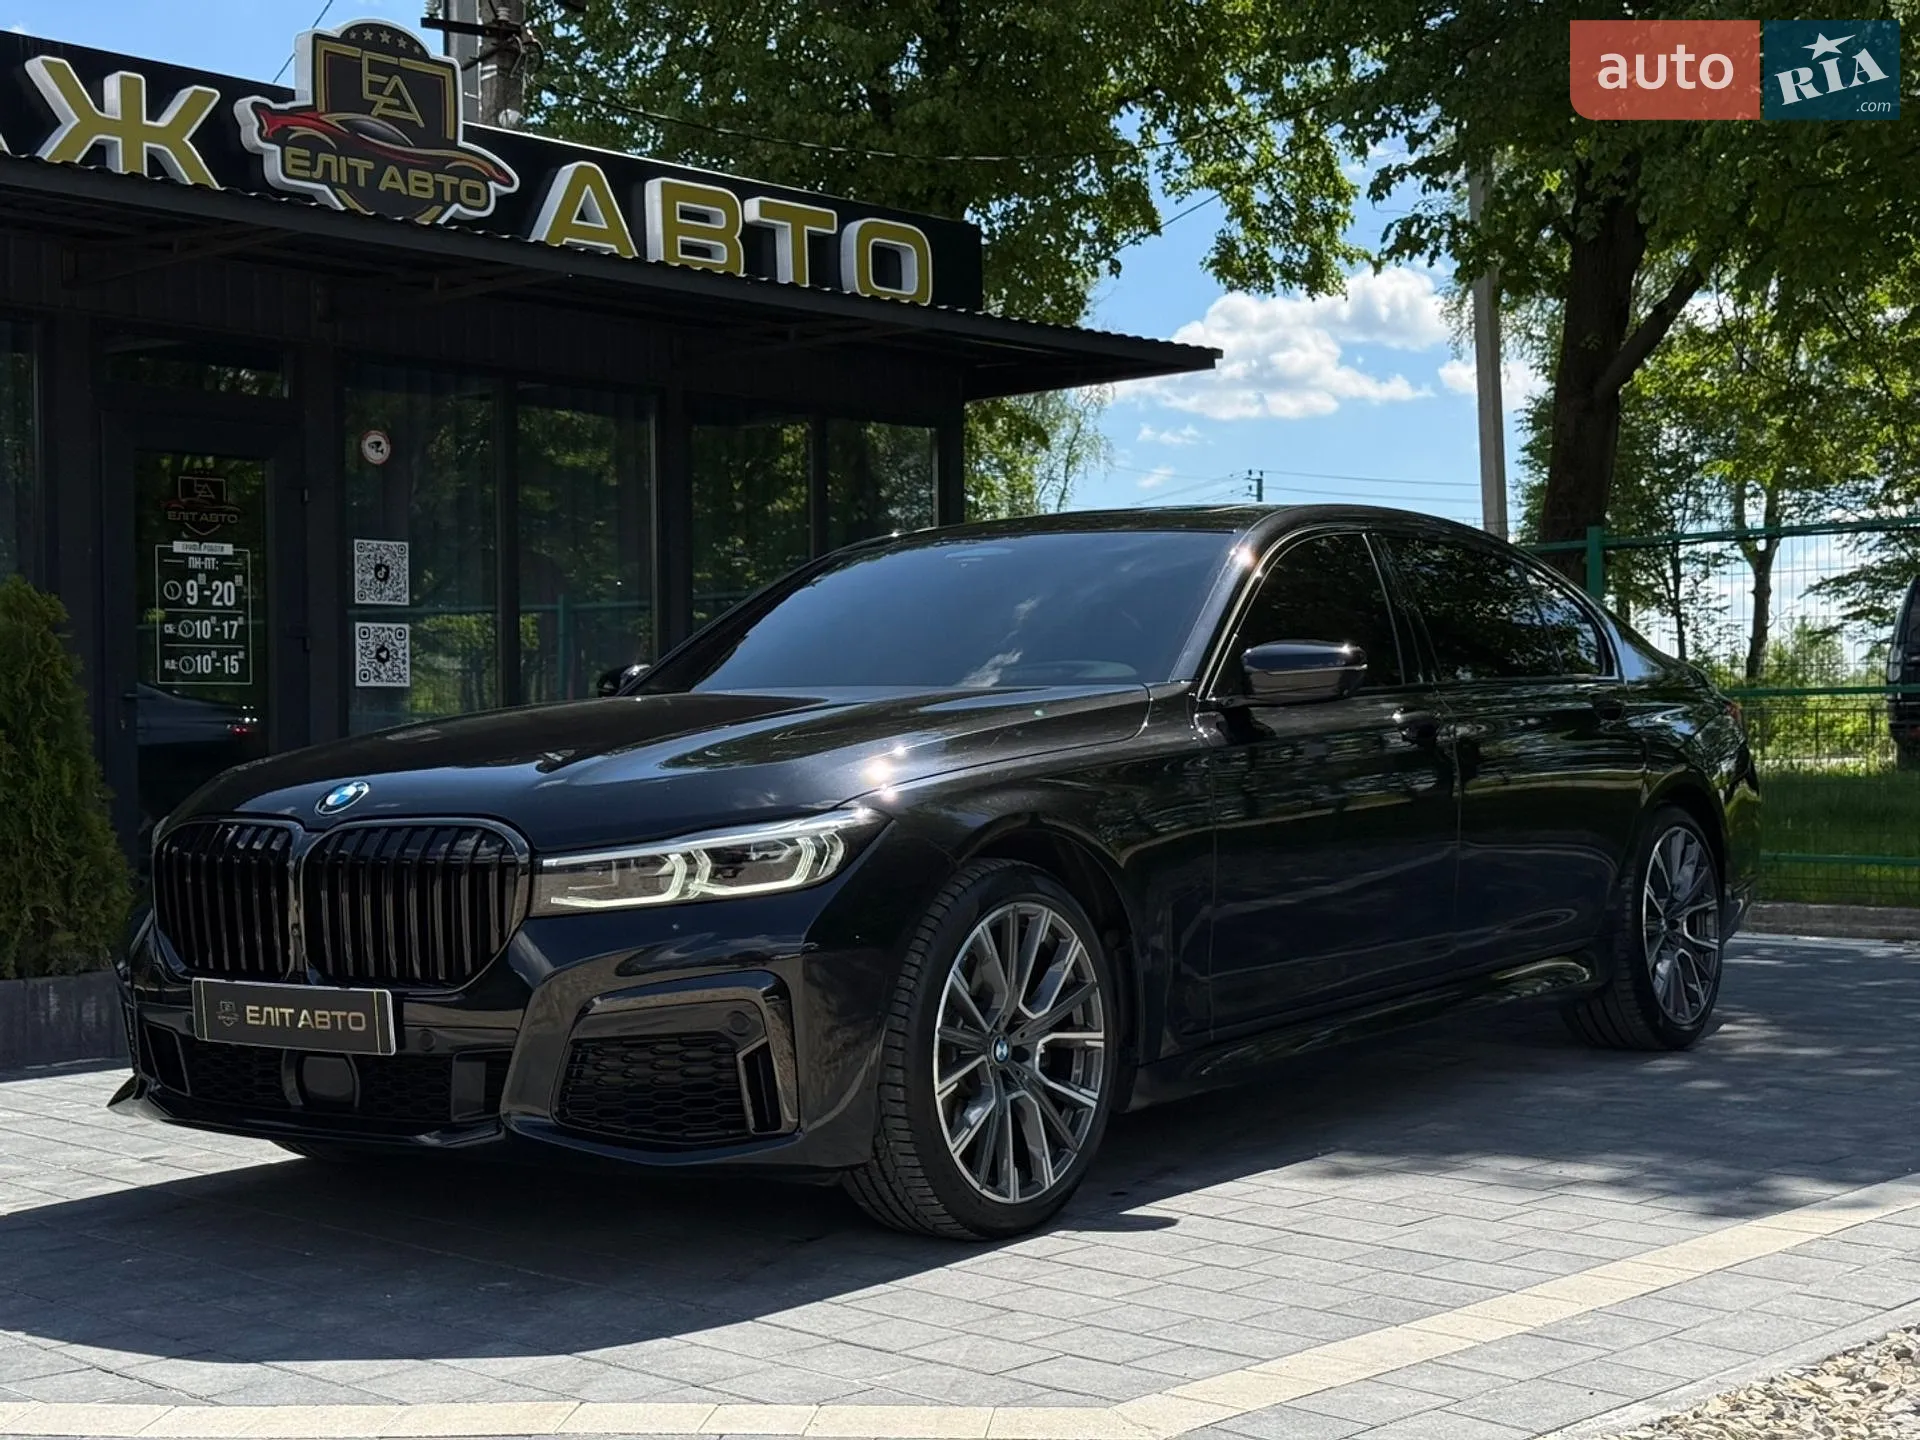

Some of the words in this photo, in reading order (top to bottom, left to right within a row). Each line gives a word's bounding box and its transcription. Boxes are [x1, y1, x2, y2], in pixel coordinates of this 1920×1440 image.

[0, 55, 221, 190] Ж
[530, 160, 933, 306] АВТО
[285, 146, 375, 188] ЕЛІТ
[379, 165, 488, 208] АВТО
[246, 1005, 295, 1027] ЕЛІТ
[297, 1009, 366, 1031] АВТО
